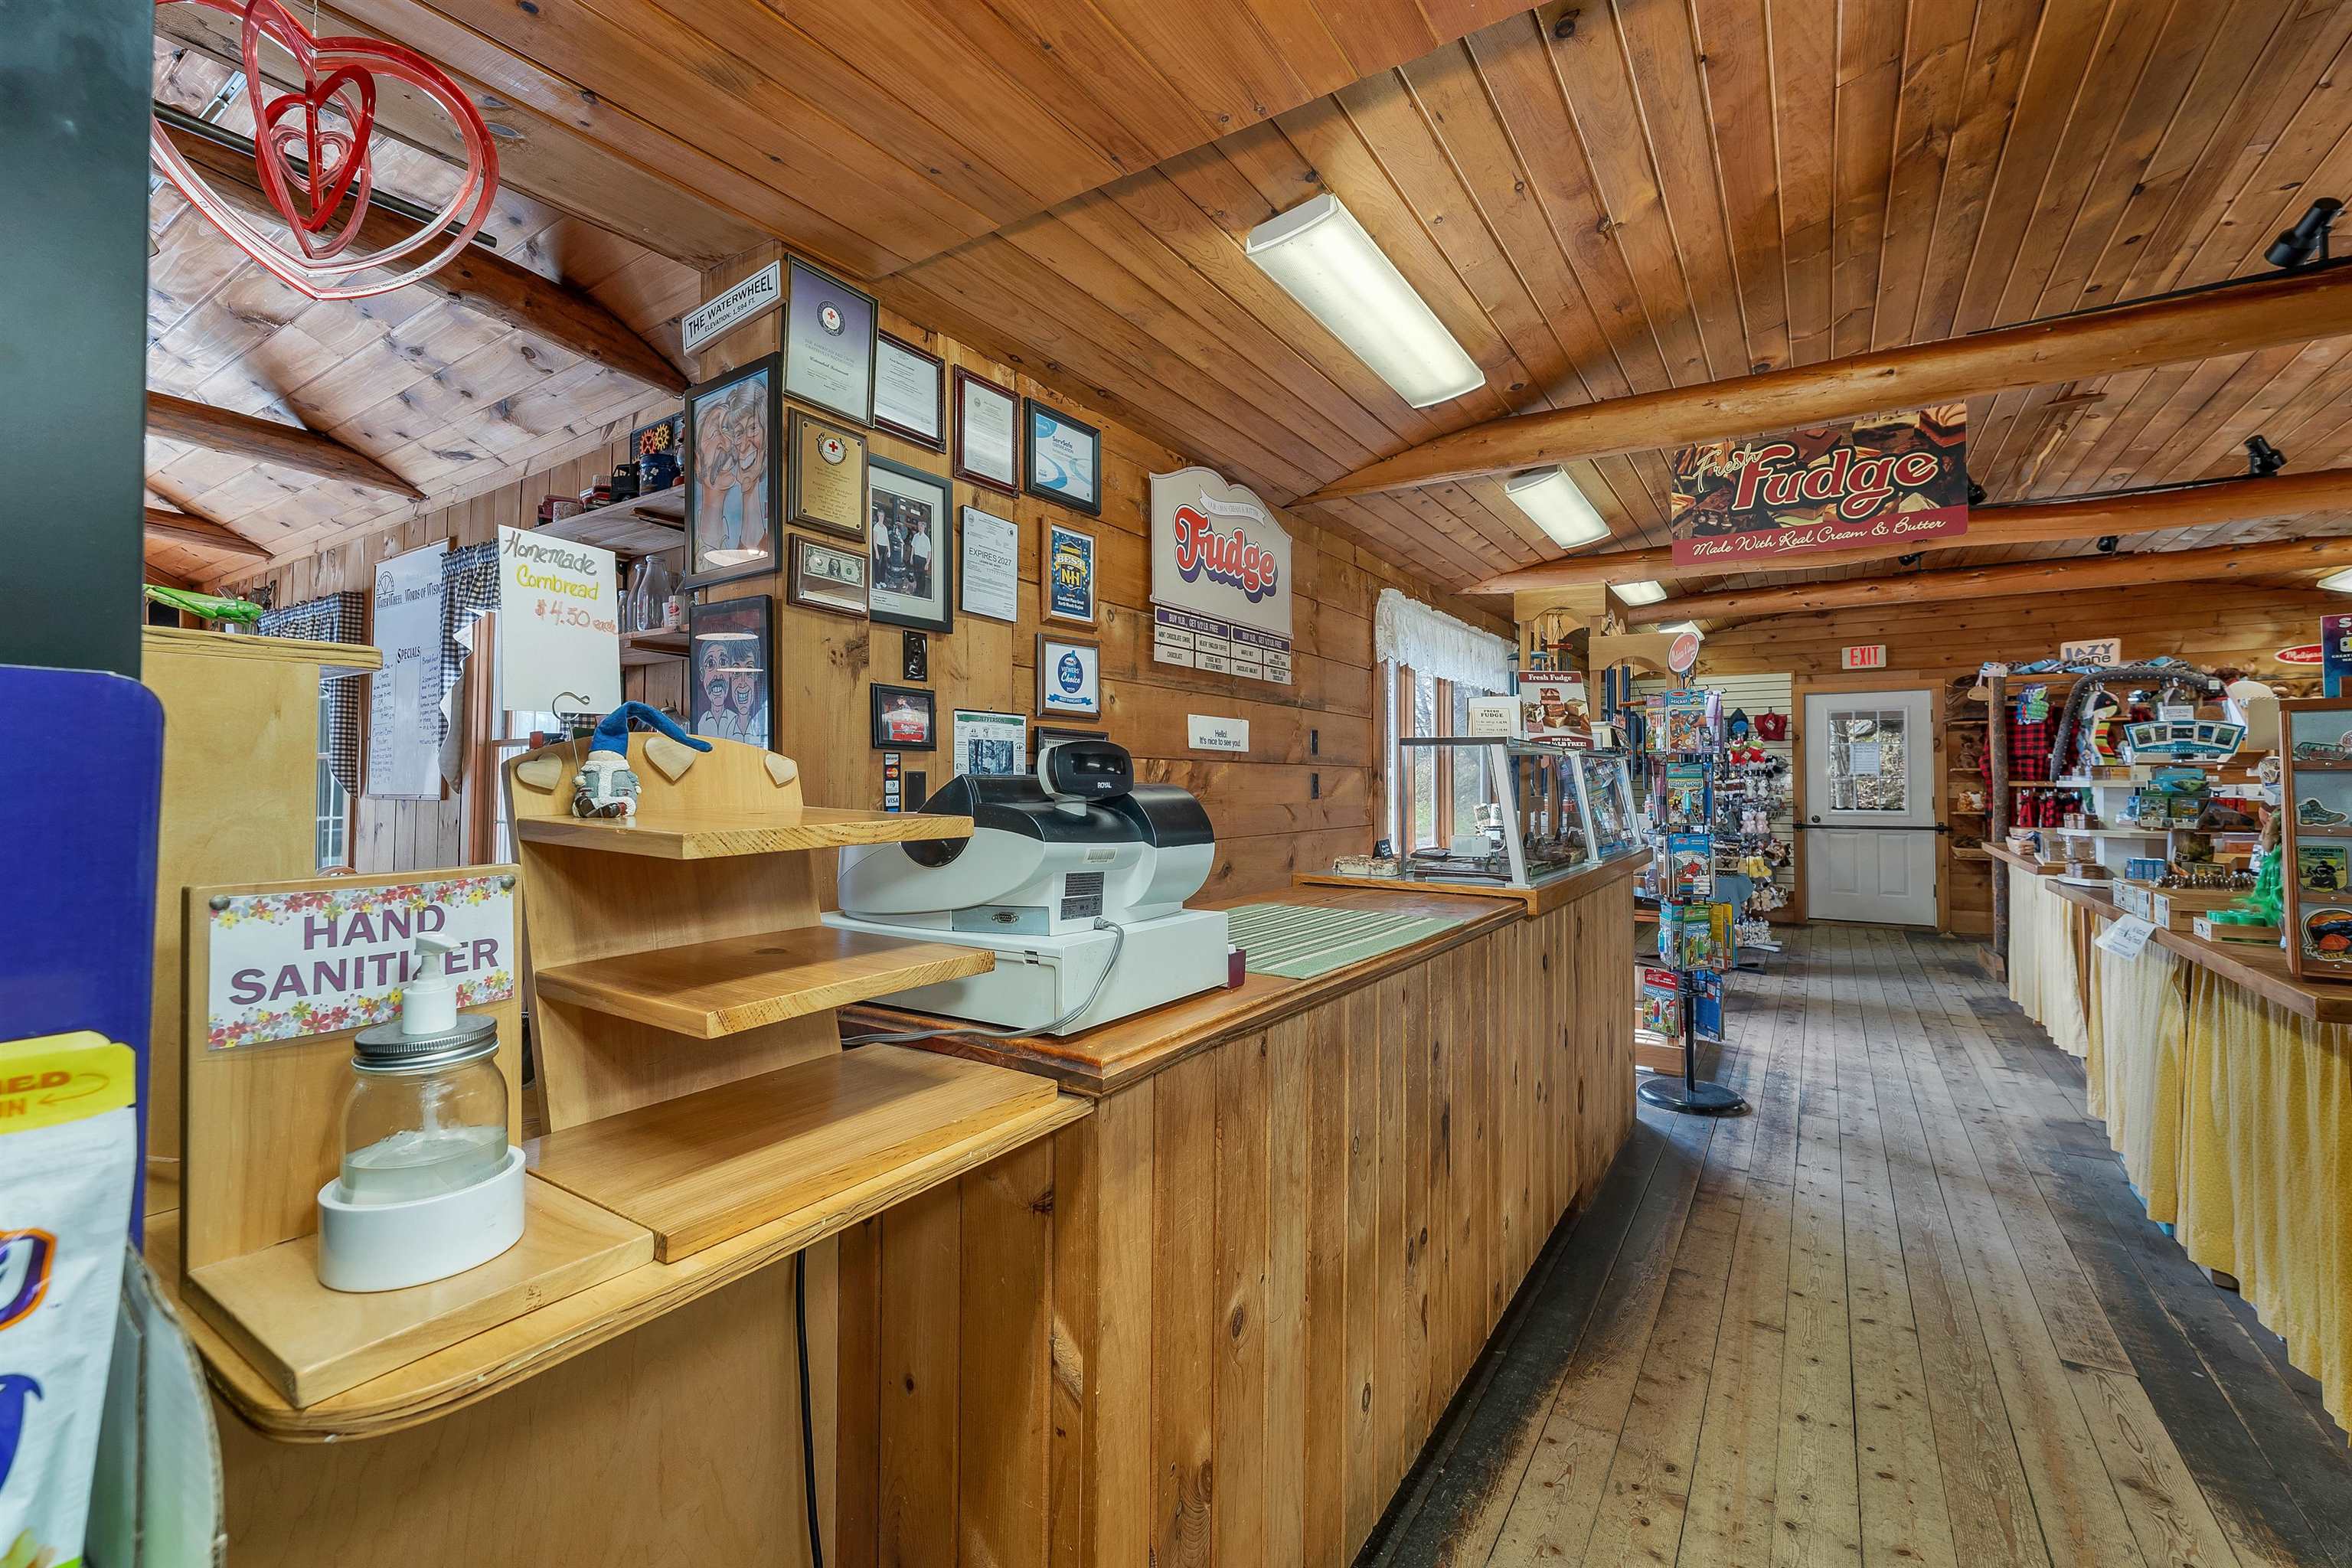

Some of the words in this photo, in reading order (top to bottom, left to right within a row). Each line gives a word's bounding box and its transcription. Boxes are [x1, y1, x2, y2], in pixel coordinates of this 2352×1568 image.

[688, 314, 705, 338] THE
[707, 274, 773, 320] WATERWHEEL
[704, 311, 732, 332] ELEVATION:
[1693, 443, 1763, 494] Fresh
[1731, 442, 1940, 521] Fudge
[1693, 540, 1733, 557] Made
[1733, 534, 1776, 551] With
[1779, 529, 1816, 547] Real
[1817, 526, 1867, 544] Cream
[1871, 521, 1889, 536] &
[1893, 515, 1946, 534] Butter
[969, 547, 998, 563] EXPIRES
[998, 556, 1011, 567] 2027
[1174, 504, 1276, 596] Fudge
[1058, 554, 1083, 569] BEST
[515, 564, 599, 601] Cornbread
[1061, 568, 1080, 586] NH
[426, 582, 443, 597] WISDO
[1168, 613, 1177, 623] BUY
[1210, 623, 1219, 634] FREE
[1166, 651, 1183, 660] CHOCOLATE
[1850, 646, 1880, 667] EXIT
[2065, 642, 2115, 662] LAZY
[1061, 671, 1080, 684] Choice
[1550, 675, 1573, 683] Fudge
[1199, 736, 1207, 745] It's
[1207, 737, 1217, 746] nice
[1214, 730, 1227, 738] Hello!
[304, 904, 446, 951] HAND
[229, 937, 499, 1006] SANITIER
